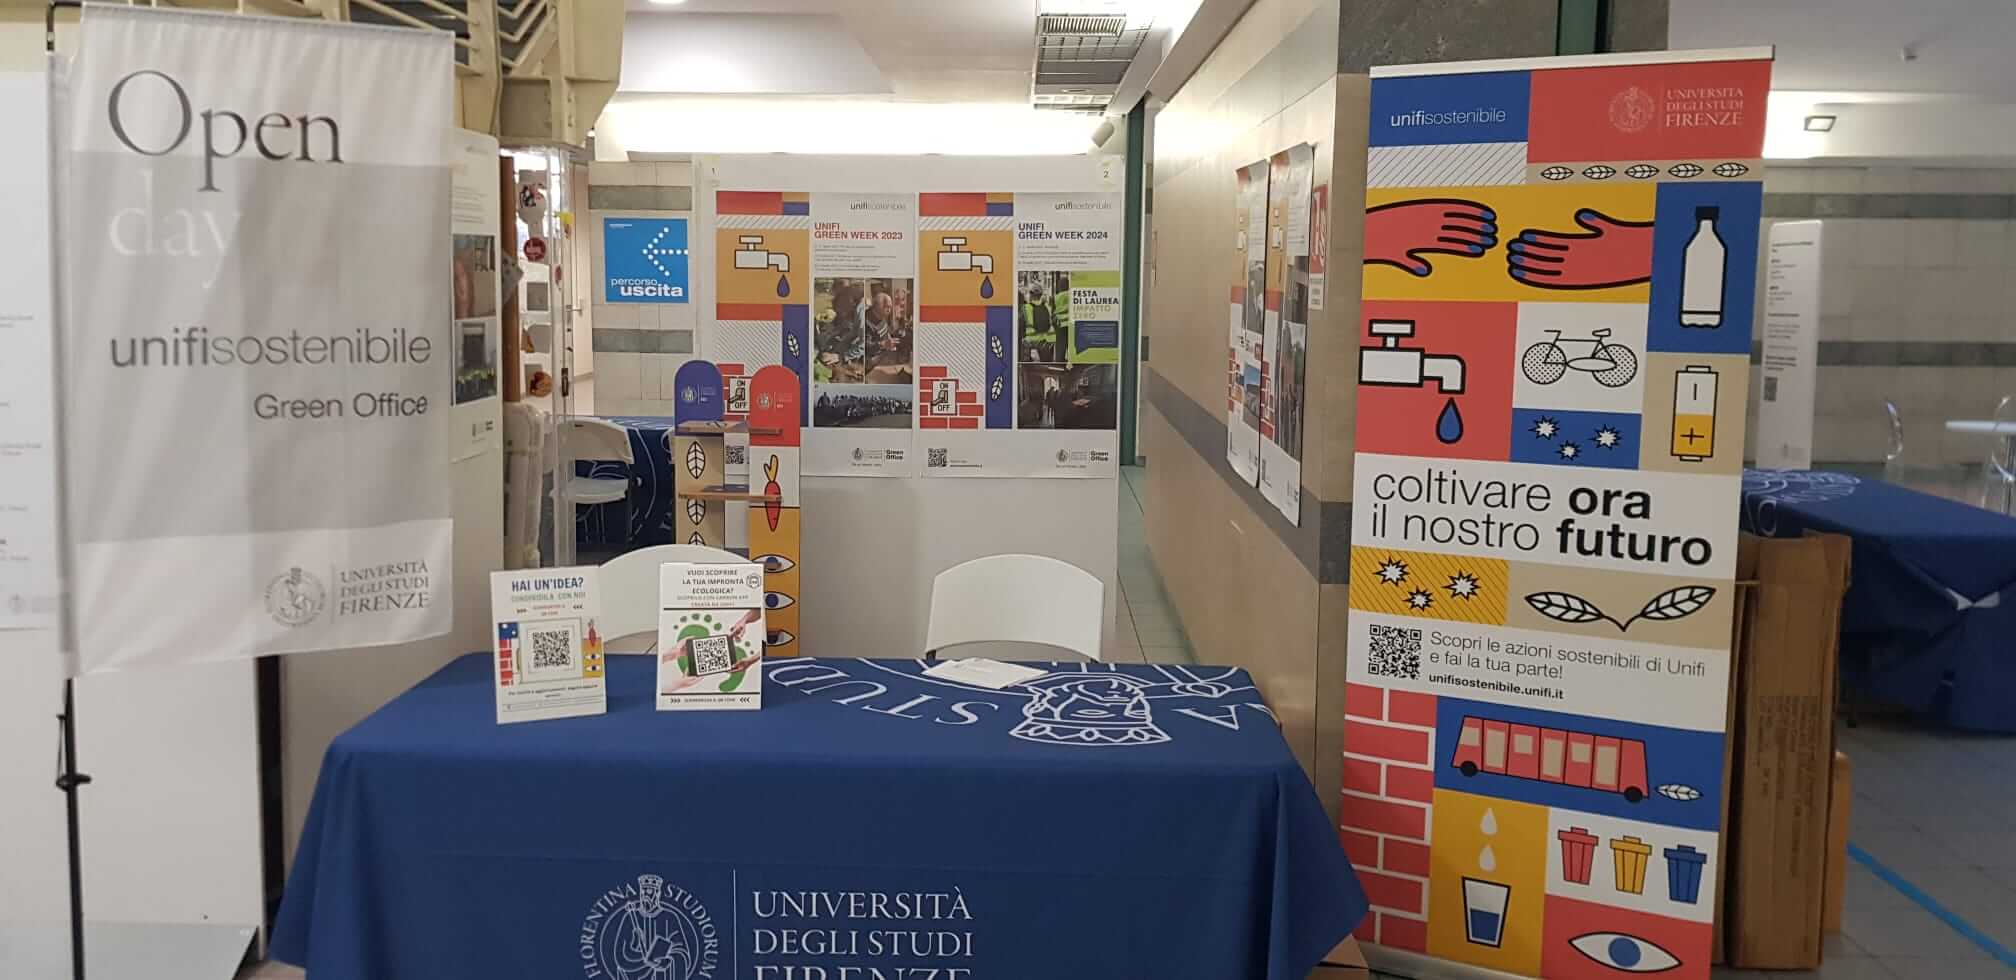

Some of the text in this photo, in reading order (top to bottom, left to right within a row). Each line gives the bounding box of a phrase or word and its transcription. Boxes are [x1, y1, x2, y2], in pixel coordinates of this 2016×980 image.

[1390, 107, 1506, 127] unifisostenibile
[1667, 100, 1744, 112] DEGLI STUDI
[108, 69, 344, 192] Open
[1666, 112, 1744, 127] FIRENZE
[108, 168, 242, 289] day
[814, 222, 840, 231] UNIFI
[814, 231, 903, 240] GREEN WEEK 2023
[1018, 222, 1045, 231] UNIFI
[1018, 231, 1108, 240] GREEN WEEK 2024
[610, 278, 657, 288] percorso
[620, 284, 683, 297] uscita
[109, 326, 431, 368] unifisostenibile
[253, 392, 428, 420] Green Office
[1373, 468, 1651, 519] coltivare ora
[1372, 503, 1712, 566] il nostro futuro
[341, 576, 429, 598] DEGLI STUDI
[511, 577, 584, 592] HAI UN'IDEA?
[340, 592, 431, 616] FIRENZE
[1430, 631, 1705, 677] Scopri le azioni sostenibili di Unifi
[1430, 651, 1563, 680] e fai la tua parte!
[1429, 674, 1564, 699] unifisostenibile.unifi.it
[752, 885, 973, 919] UNIVERSITÀ
[580, 883, 719, 979] FLORENTINA STUDIORUM
[753, 929, 974, 956] DEGLI STUDI
